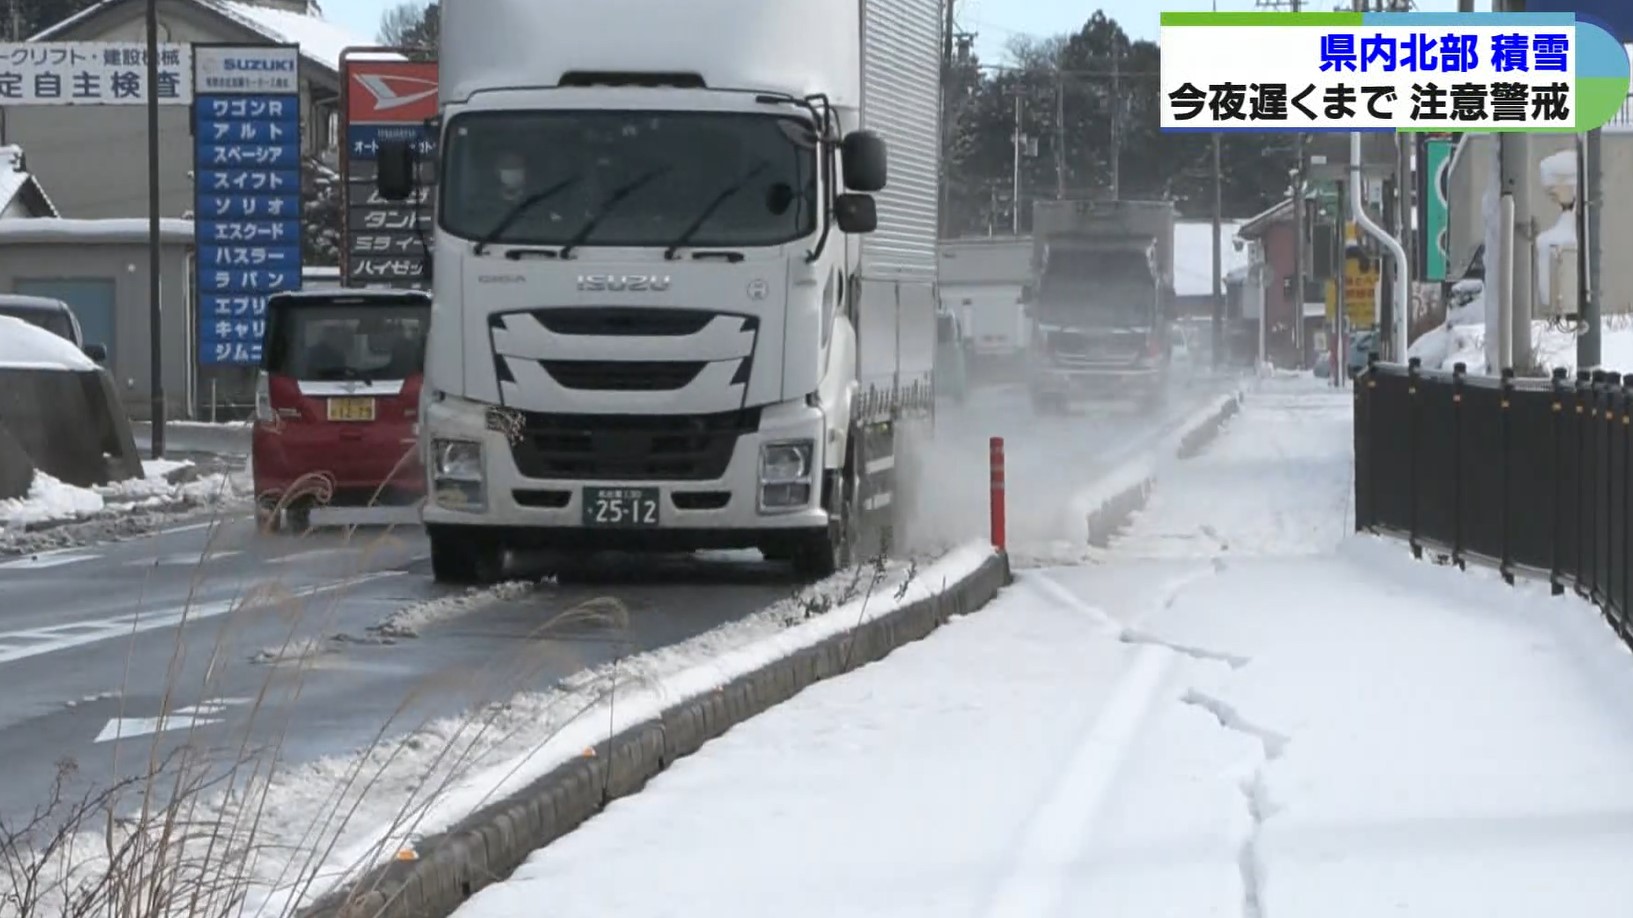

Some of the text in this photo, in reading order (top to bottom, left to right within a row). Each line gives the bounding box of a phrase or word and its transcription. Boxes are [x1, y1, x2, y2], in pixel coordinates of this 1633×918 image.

[0, 48, 180, 66] ークリフト・建設械
[224, 58, 294, 71] SUZUKI
[213, 100, 283, 116] ワゴンR
[213, 122, 283, 139] アルト
[213, 145, 283, 163] スペーシア
[214, 172, 283, 189] スイフト
[215, 197, 284, 215] ソリオ
[215, 223, 284, 239] エスクード
[215, 247, 285, 264] ハスラー
[354, 260, 424, 275] ハイゼッ
[577, 275, 670, 291] ISUZU
[215, 297, 266, 315] エブリ
[215, 321, 265, 338] キャリ
[215, 342, 262, 361] ジムニ
[596, 499, 657, 523] 25-12
